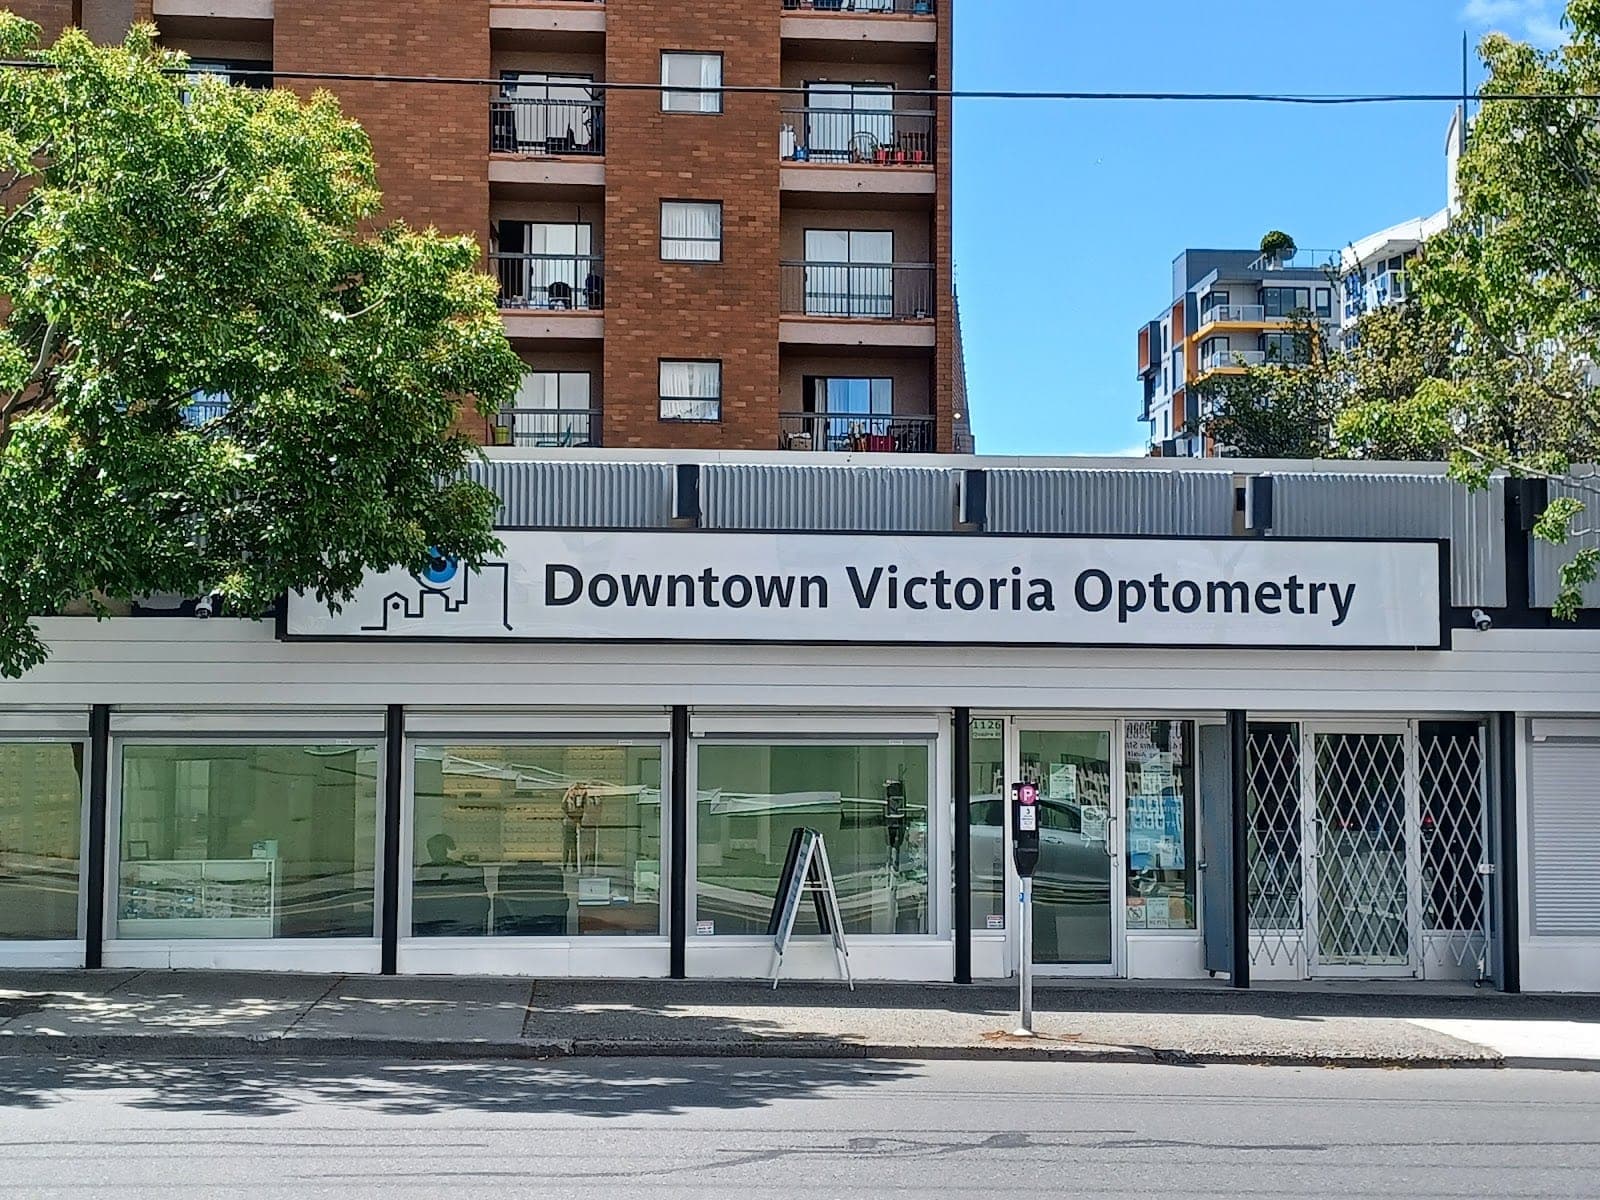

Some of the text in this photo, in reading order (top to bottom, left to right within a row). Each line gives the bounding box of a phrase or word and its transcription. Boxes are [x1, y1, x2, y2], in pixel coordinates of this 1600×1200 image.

[544, 563, 1356, 628] Downtown Victoria Optometry
[973, 720, 1001, 729] 1126
[1023, 789, 1033, 801] P
